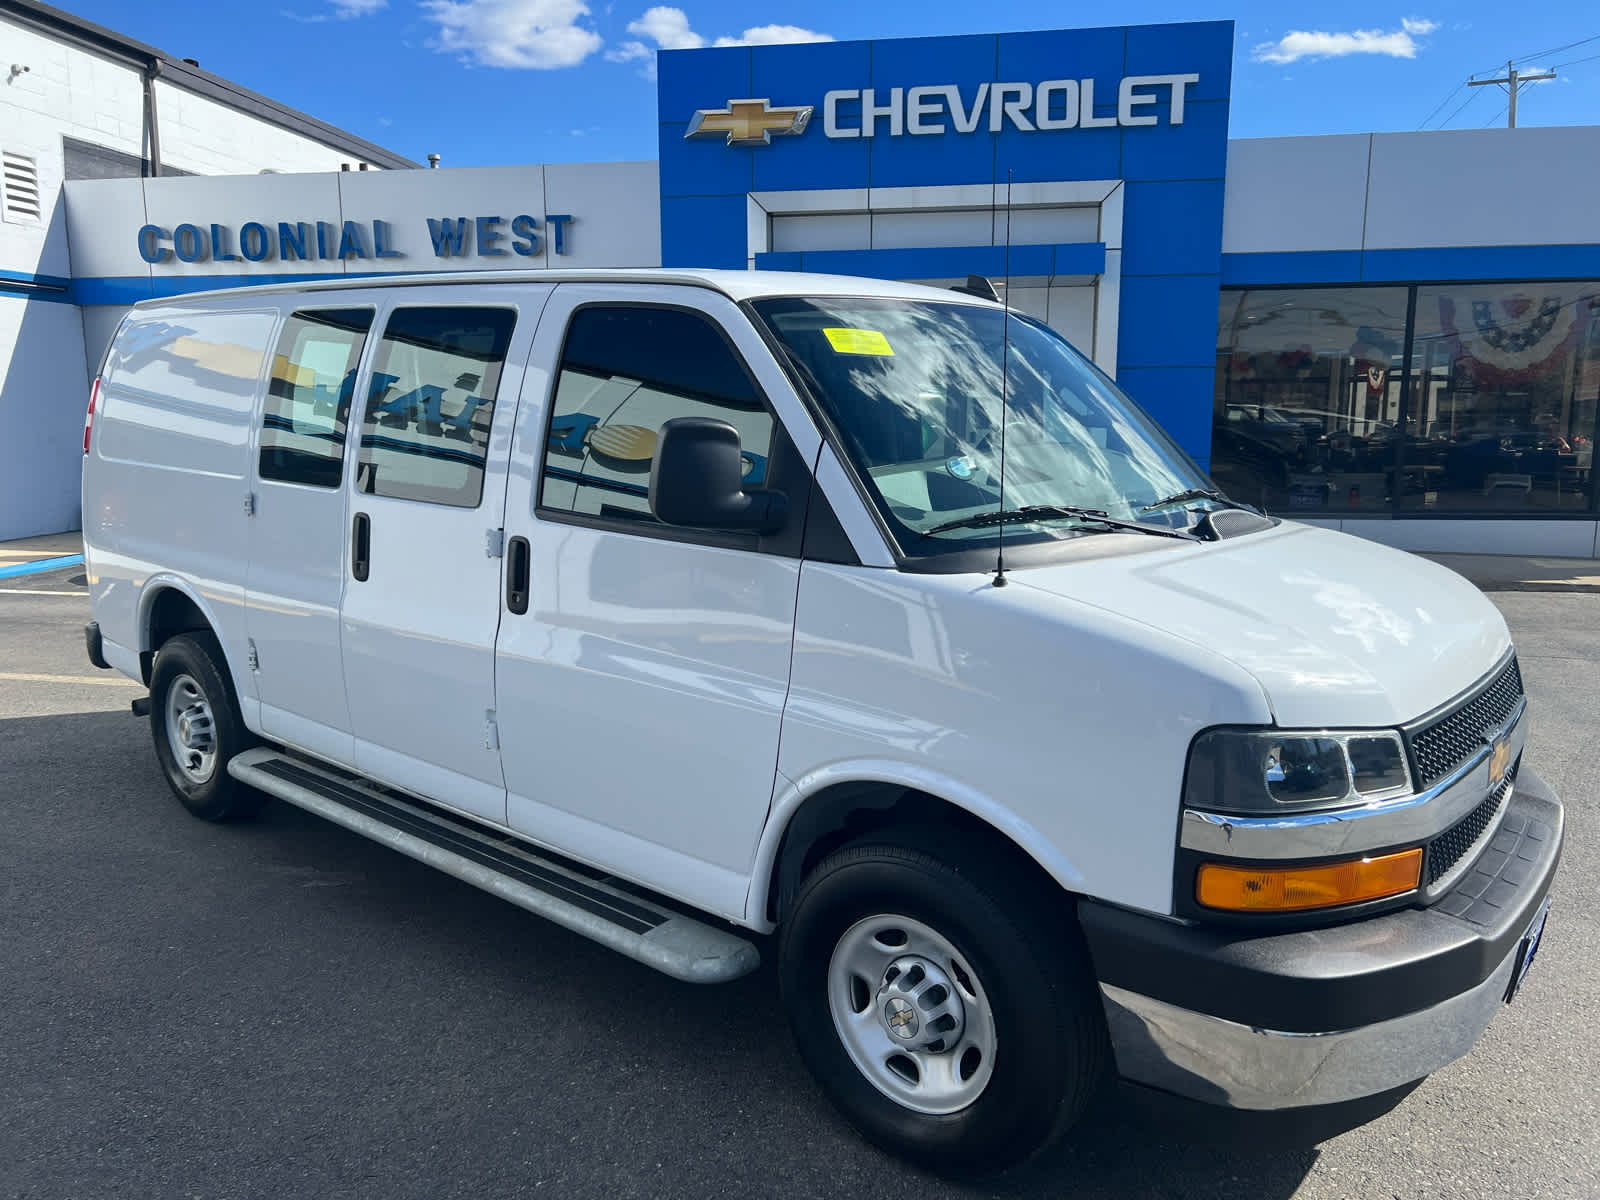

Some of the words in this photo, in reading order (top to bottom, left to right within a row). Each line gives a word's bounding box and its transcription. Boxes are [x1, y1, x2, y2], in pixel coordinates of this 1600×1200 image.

[823, 73, 1200, 139] CHEVROLET
[137, 219, 404, 264] COLONIAL
[426, 213, 575, 258] WEST
